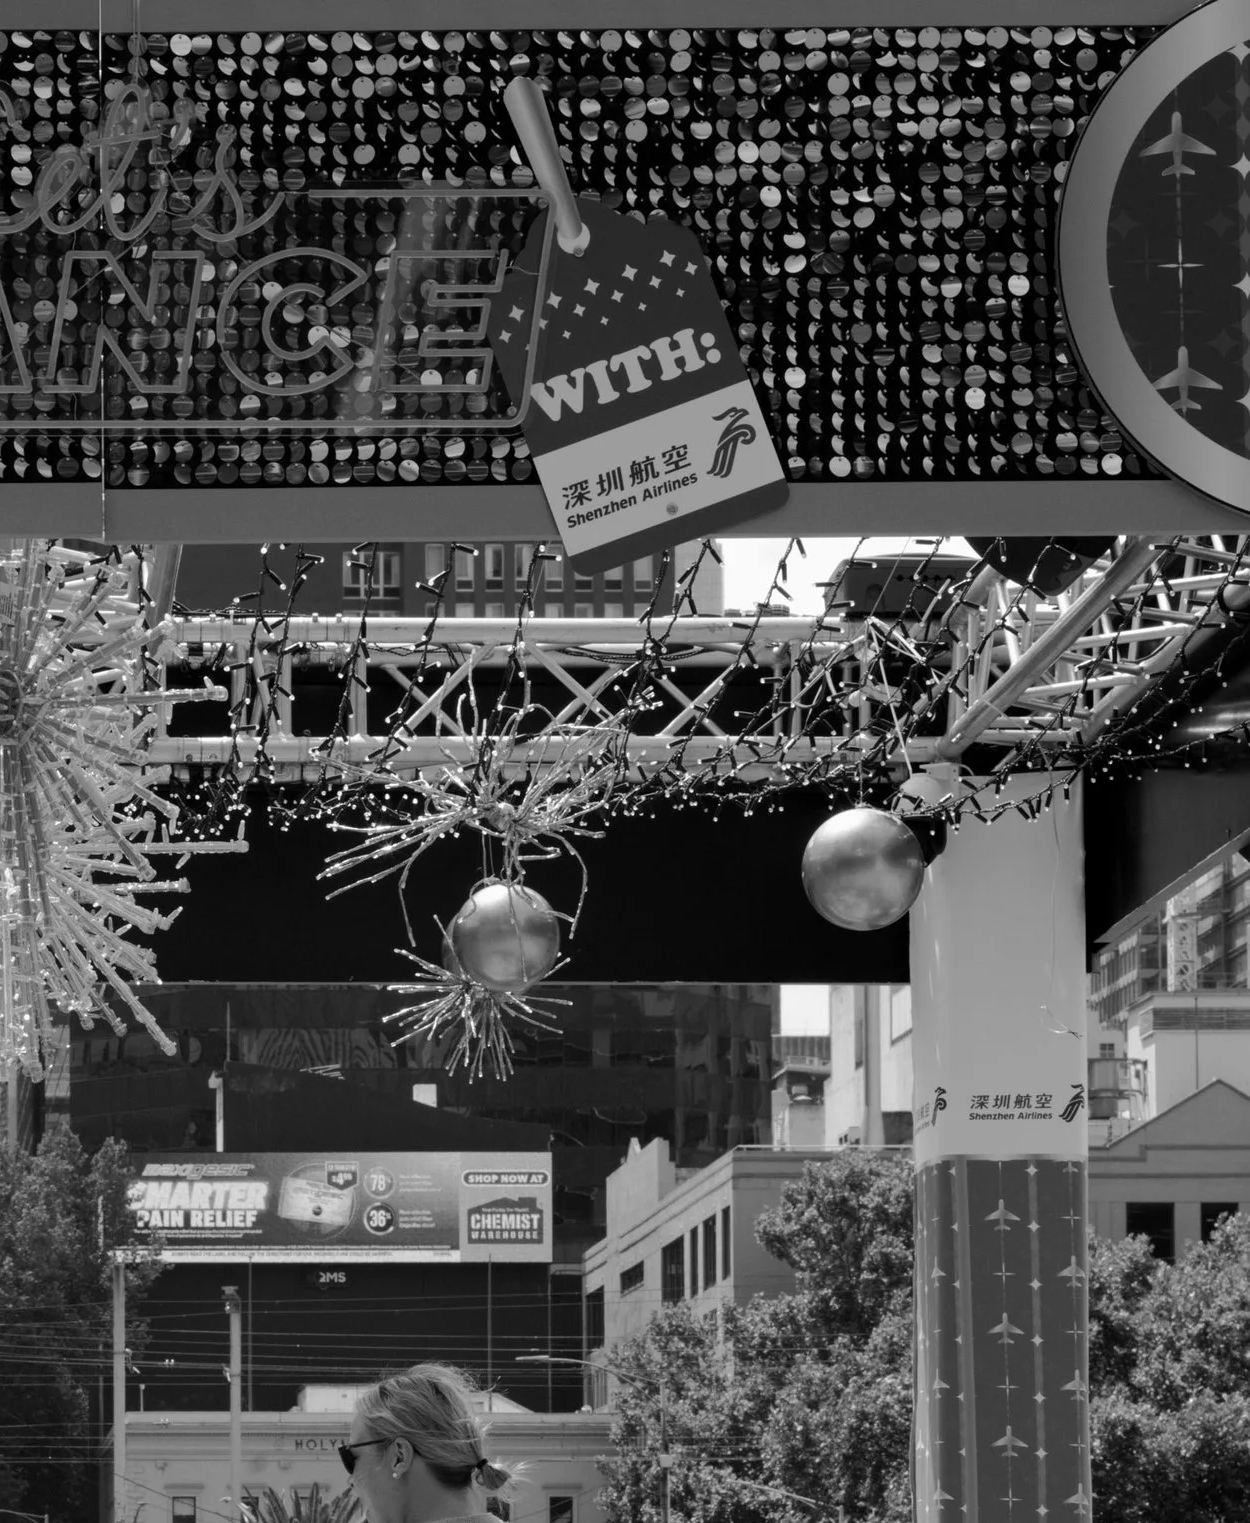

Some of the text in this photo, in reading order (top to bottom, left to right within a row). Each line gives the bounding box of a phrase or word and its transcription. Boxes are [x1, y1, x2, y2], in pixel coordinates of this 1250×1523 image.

[530, 328, 721, 422] WITH:
[561, 444, 691, 510] 深圳航空
[566, 472, 698, 528] Shenzhen Airlines
[970, 1093, 1053, 1109] 深圳航空
[969, 1111, 1053, 1120] Shenzhen Airlines
[468, 1174, 544, 1183] SHOP NOW AT
[127, 1181, 268, 1210] SMARTER
[136, 1210, 258, 1228] PAIN RELIEF
[471, 1213, 540, 1230] CHEMIST
[471, 1231, 538, 1239] WAREHOUSE
